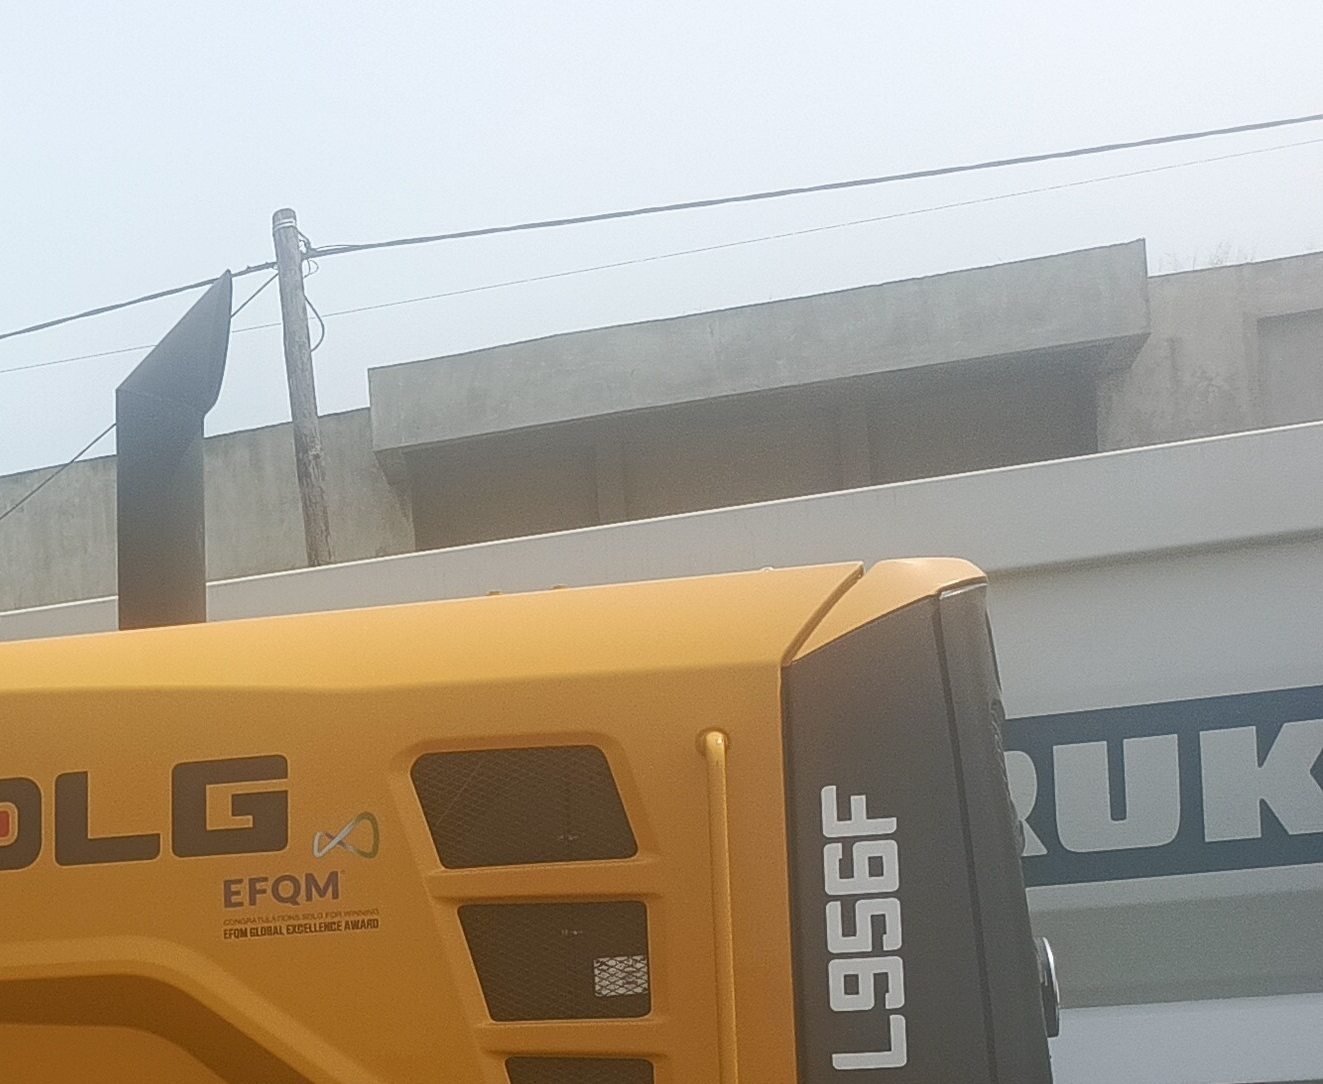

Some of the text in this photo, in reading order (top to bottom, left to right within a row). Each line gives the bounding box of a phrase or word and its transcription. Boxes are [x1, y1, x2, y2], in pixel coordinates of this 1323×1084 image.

[223, 870, 340, 908] EFQM
[249, 924, 285, 938] GLOBAL
[286, 920, 343, 935] EXCELLENCE
[344, 917, 380, 932] AWARD
[821, 785, 907, 1070] L956F
